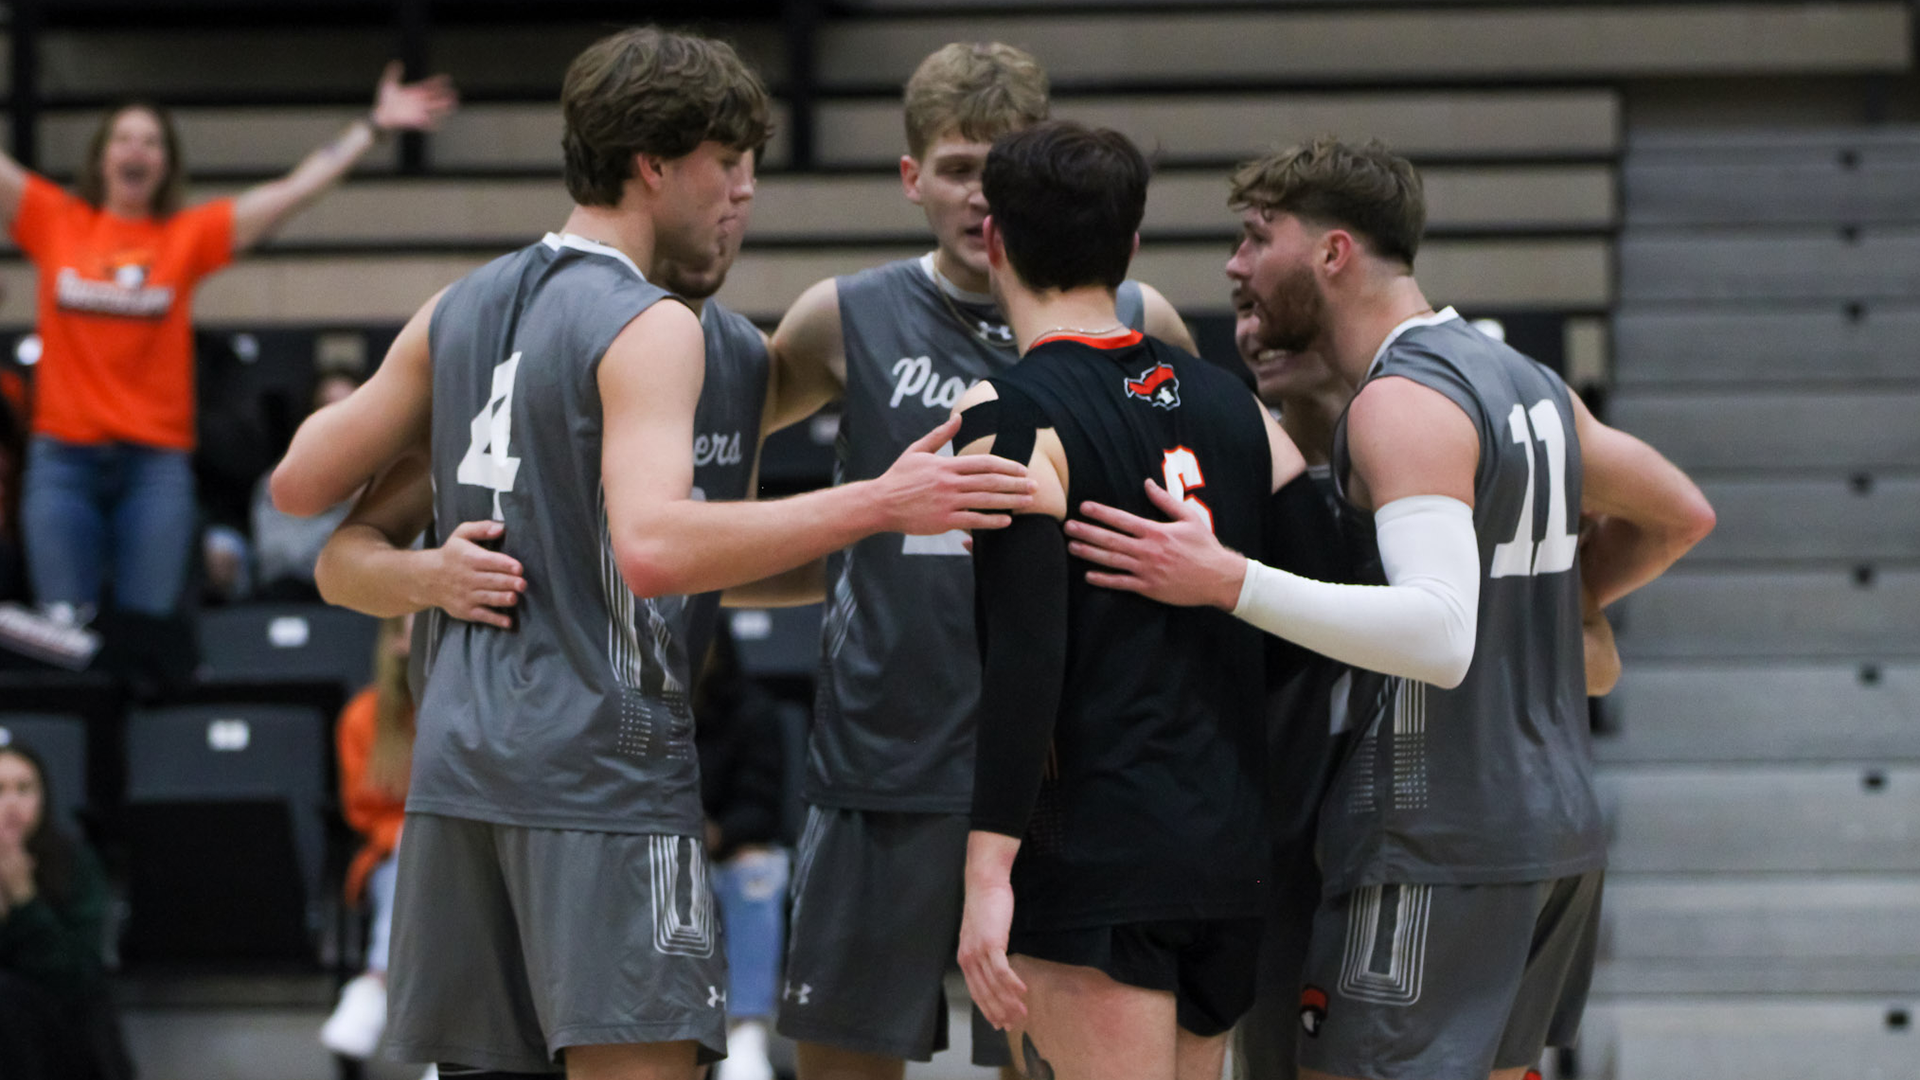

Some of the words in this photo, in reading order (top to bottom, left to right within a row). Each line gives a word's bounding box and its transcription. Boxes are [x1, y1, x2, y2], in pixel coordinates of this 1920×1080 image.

[457, 351, 521, 522] 4
[890, 355, 979, 408] Pio
[1161, 444, 1215, 535] 6
[1490, 398, 1578, 578] 11
